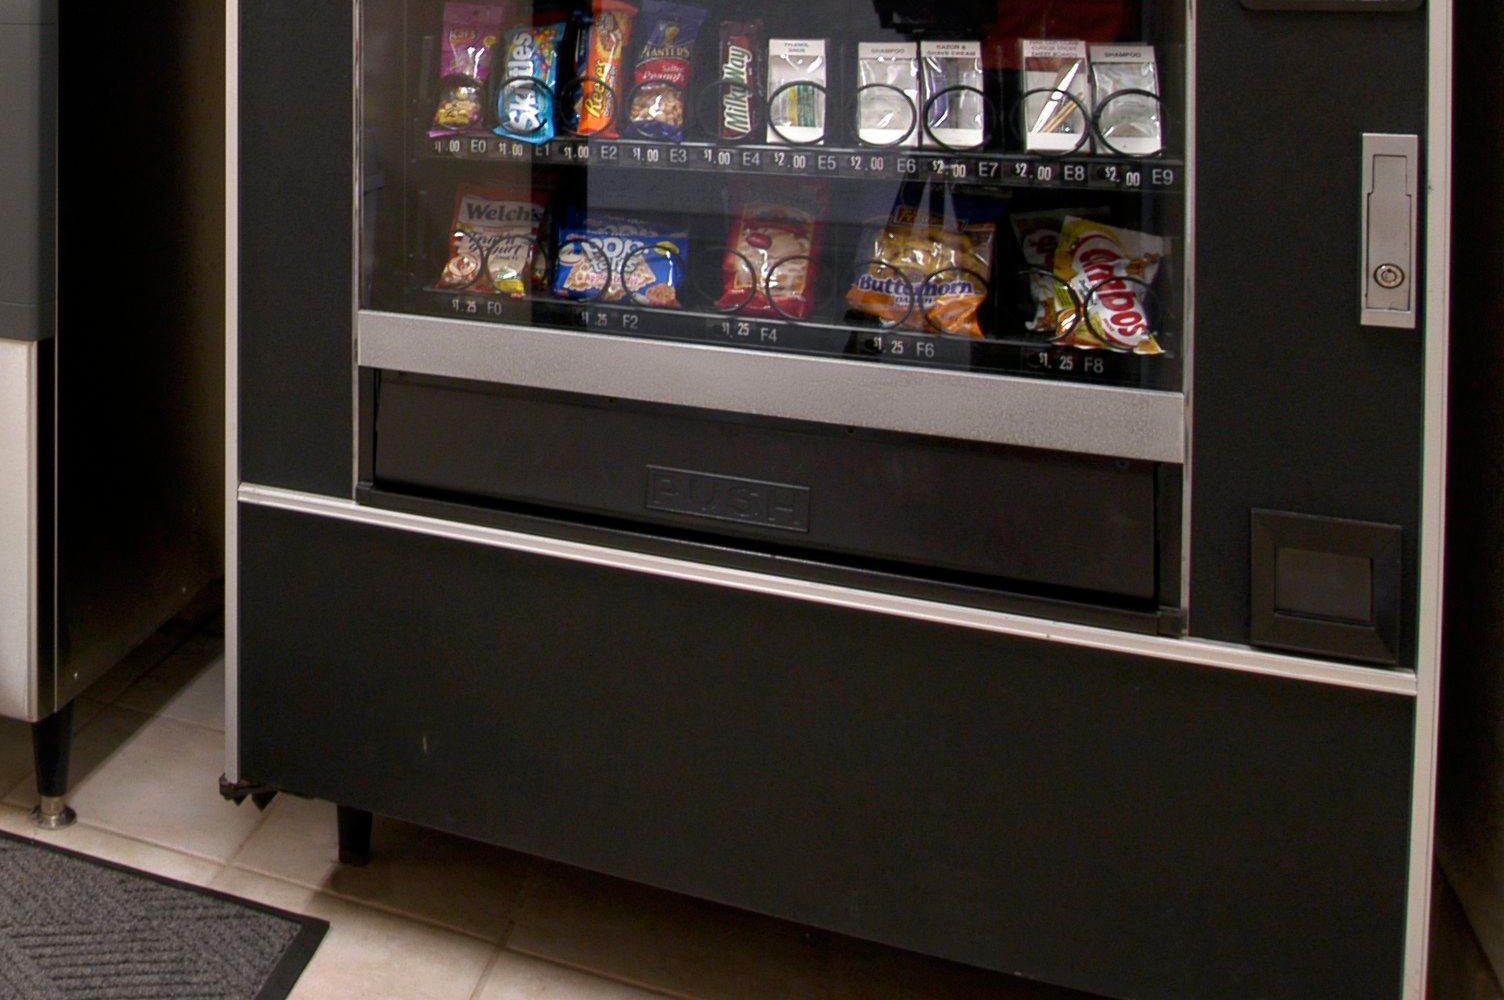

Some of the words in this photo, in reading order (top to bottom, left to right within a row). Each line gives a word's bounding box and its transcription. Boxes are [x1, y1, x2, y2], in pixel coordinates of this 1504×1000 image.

[470, 138, 486, 152] E0
[601, 147, 617, 160] E2
[670, 149, 687, 163] E3
[743, 152, 760, 166] E4
[818, 156, 837, 169] E5
[897, 159, 917, 173] E6
[978, 162, 998, 177] E7
[1064, 165, 1085, 181] E8
[1152, 169, 1174, 185] E9
[487, 301, 502, 315] F0
[622, 315, 638, 329] F2
[761, 327, 777, 342] F4
[916, 342, 934, 358] F6
[1084, 357, 1104, 374] F8
